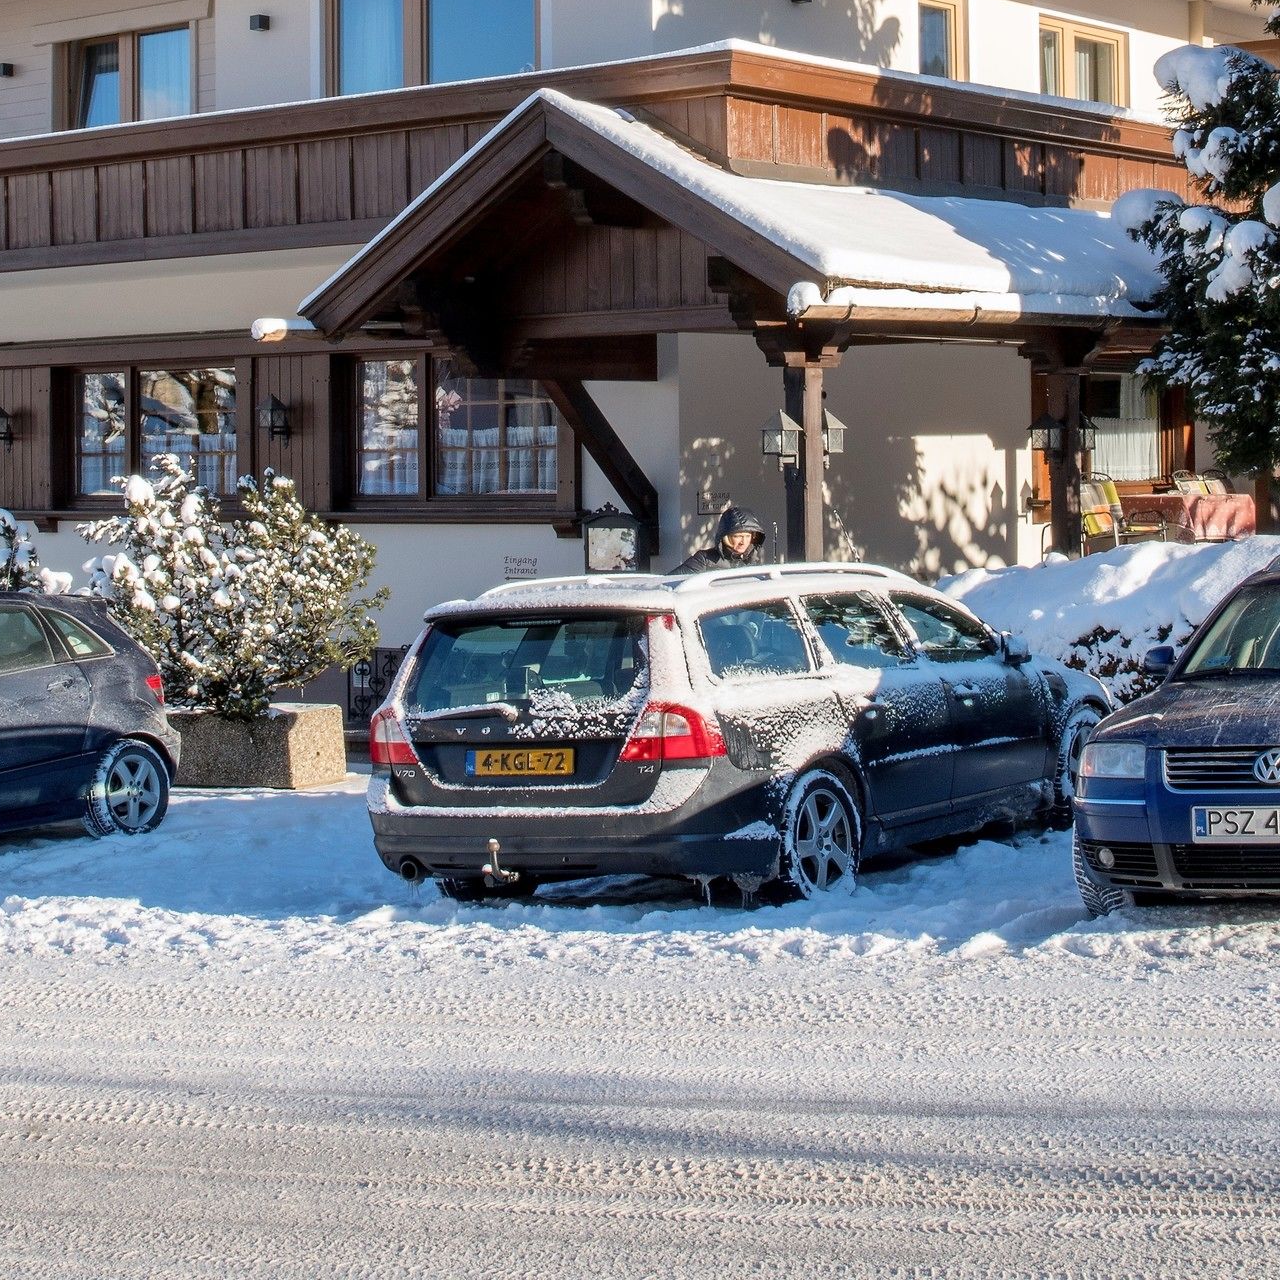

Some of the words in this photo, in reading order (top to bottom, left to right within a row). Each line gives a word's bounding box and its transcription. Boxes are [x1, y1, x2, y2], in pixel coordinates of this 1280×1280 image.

[504, 556, 537, 567] Eingang
[504, 566, 537, 575] Entrance
[482, 753, 566, 771] 4-KGL-72
[396, 770, 416, 778] V70
[638, 765, 654, 774] T4
[1208, 810, 1255, 835] PSZ
